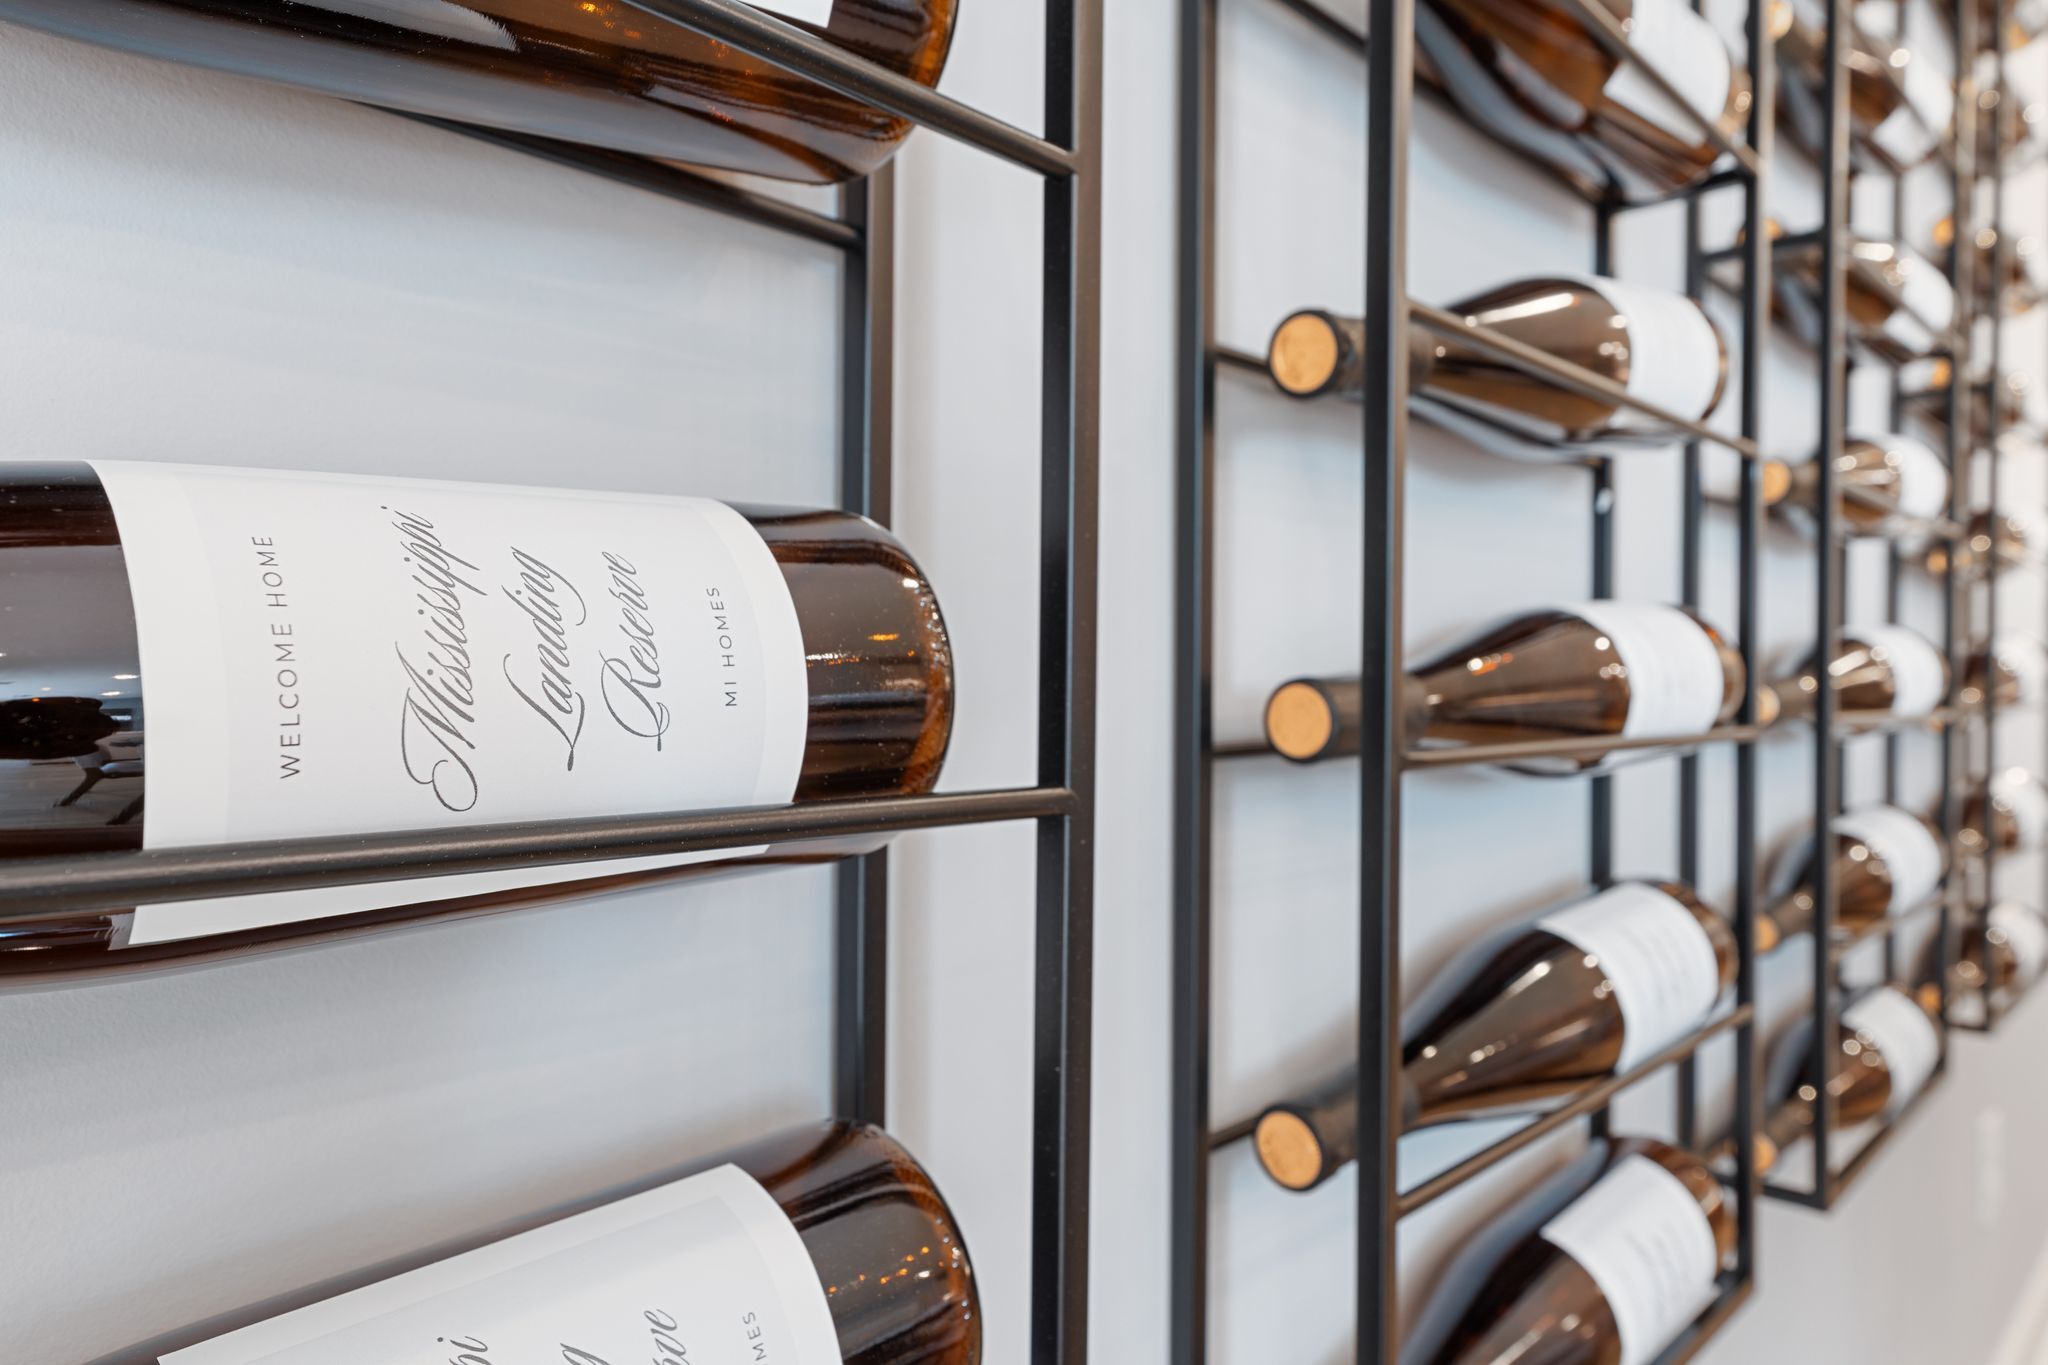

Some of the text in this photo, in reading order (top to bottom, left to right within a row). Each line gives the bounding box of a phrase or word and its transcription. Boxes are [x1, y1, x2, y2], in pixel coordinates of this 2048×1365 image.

[251, 536, 301, 780] WELCOME HOME
[380, 505, 489, 813] Mississippi
[501, 545, 587, 772] Landing
[598, 551, 671, 753] Reserve
[706, 587, 738, 707] MI HOMES
